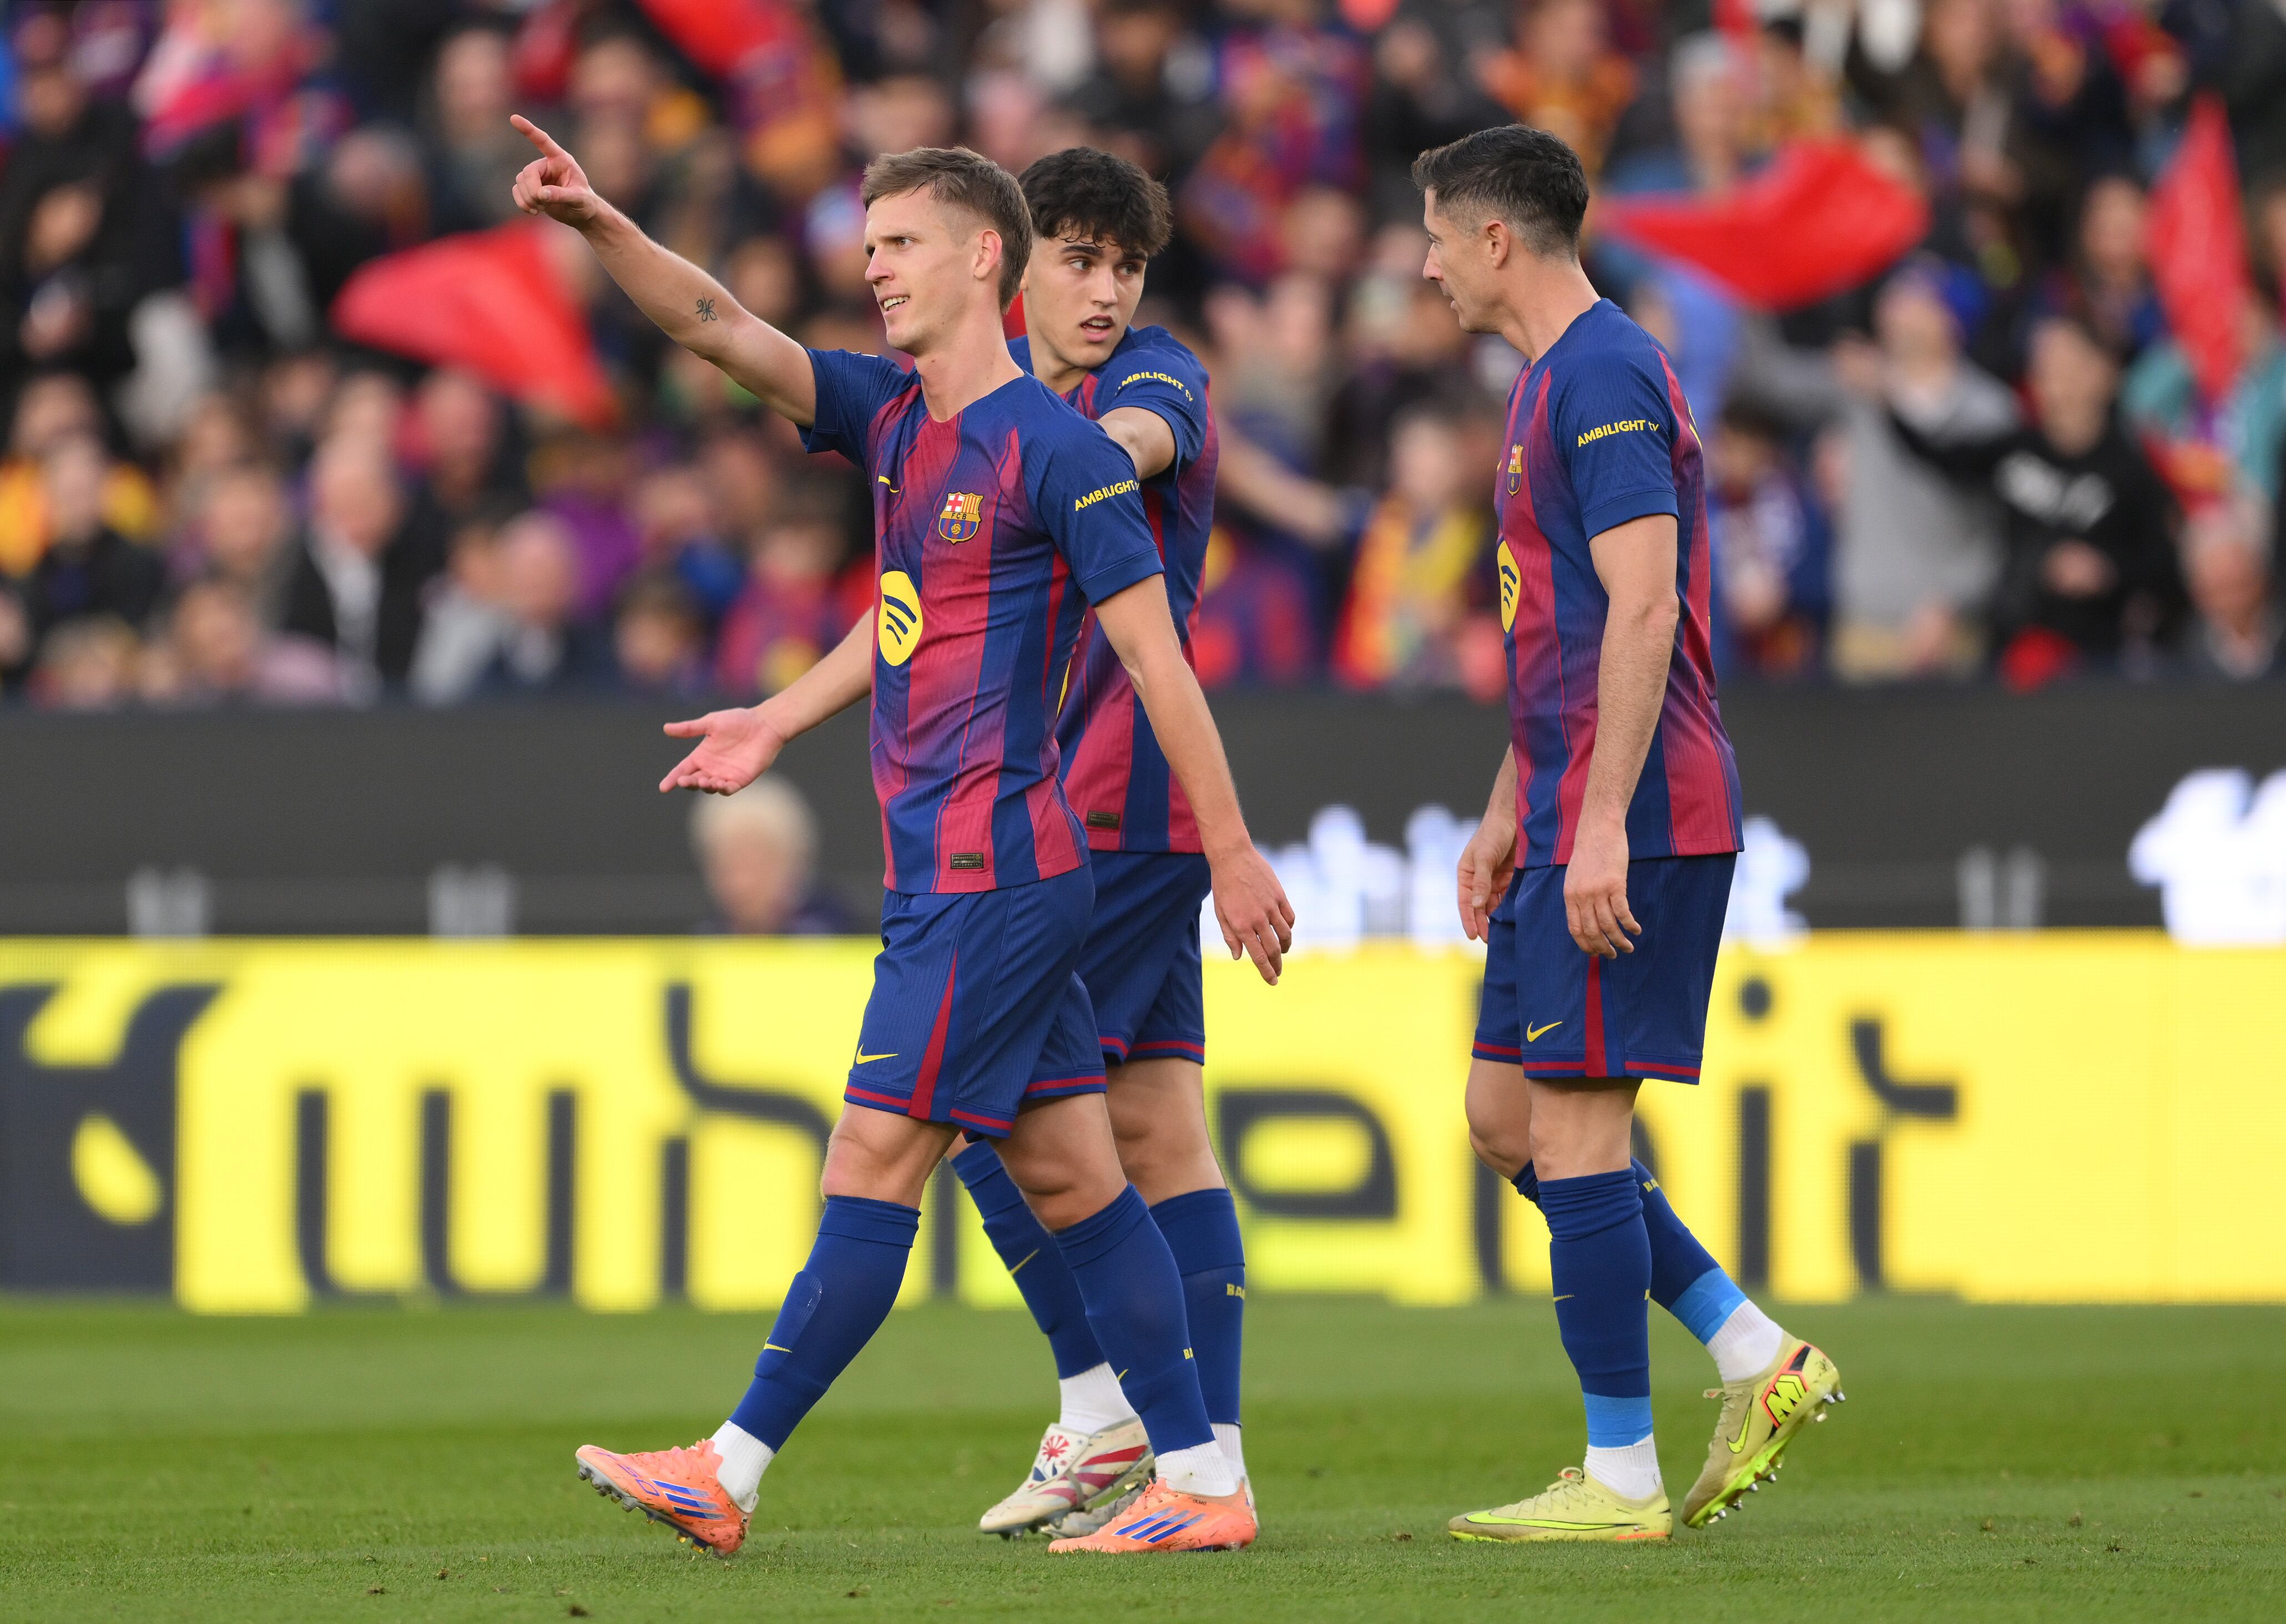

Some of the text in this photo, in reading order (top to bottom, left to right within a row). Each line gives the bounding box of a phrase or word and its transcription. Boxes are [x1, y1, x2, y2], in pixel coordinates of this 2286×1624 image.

[1577, 419, 1659, 447] AMBILIGHT tv
[1075, 479, 1135, 511] AMBILIGHT
[291, 978, 1956, 1301] wheit
[1227, 1283, 1245, 1300] BA
